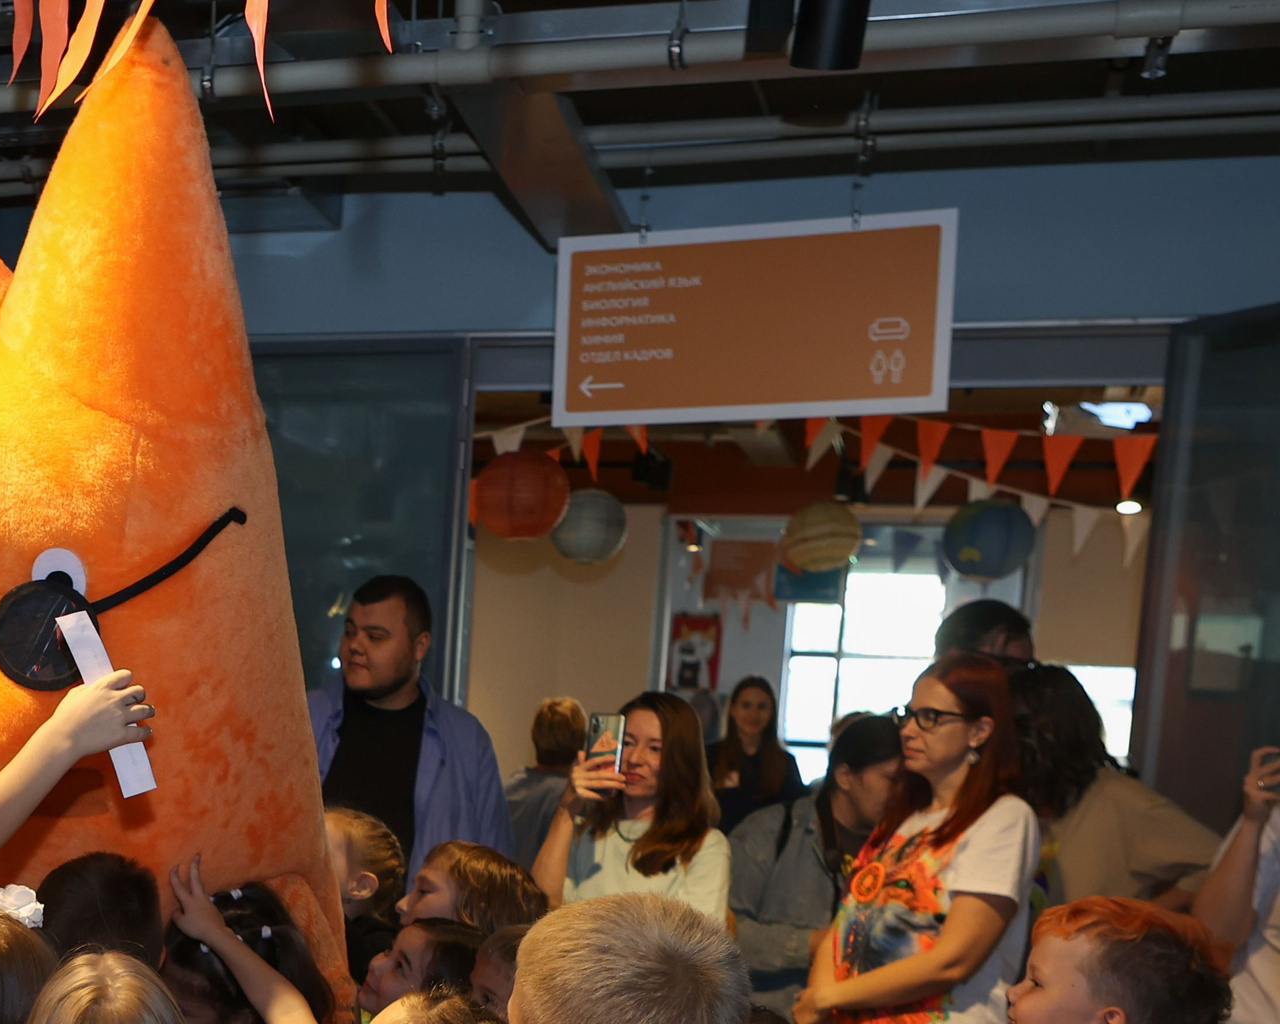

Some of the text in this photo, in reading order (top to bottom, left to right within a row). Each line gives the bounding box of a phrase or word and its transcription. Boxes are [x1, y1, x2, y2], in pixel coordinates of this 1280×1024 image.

[586, 262, 662, 275] ЭКОНОМИКА
[584, 277, 701, 292] АНГЛИЙСКИЙ ЯЗЫК
[582, 298, 649, 311] БИОЛОГИЯ
[581, 314, 676, 327] ИНФОРМАТИКА
[581, 334, 624, 345] ХИМИЯ
[580, 348, 674, 363] ОТДЕЛ КАДРОВ
